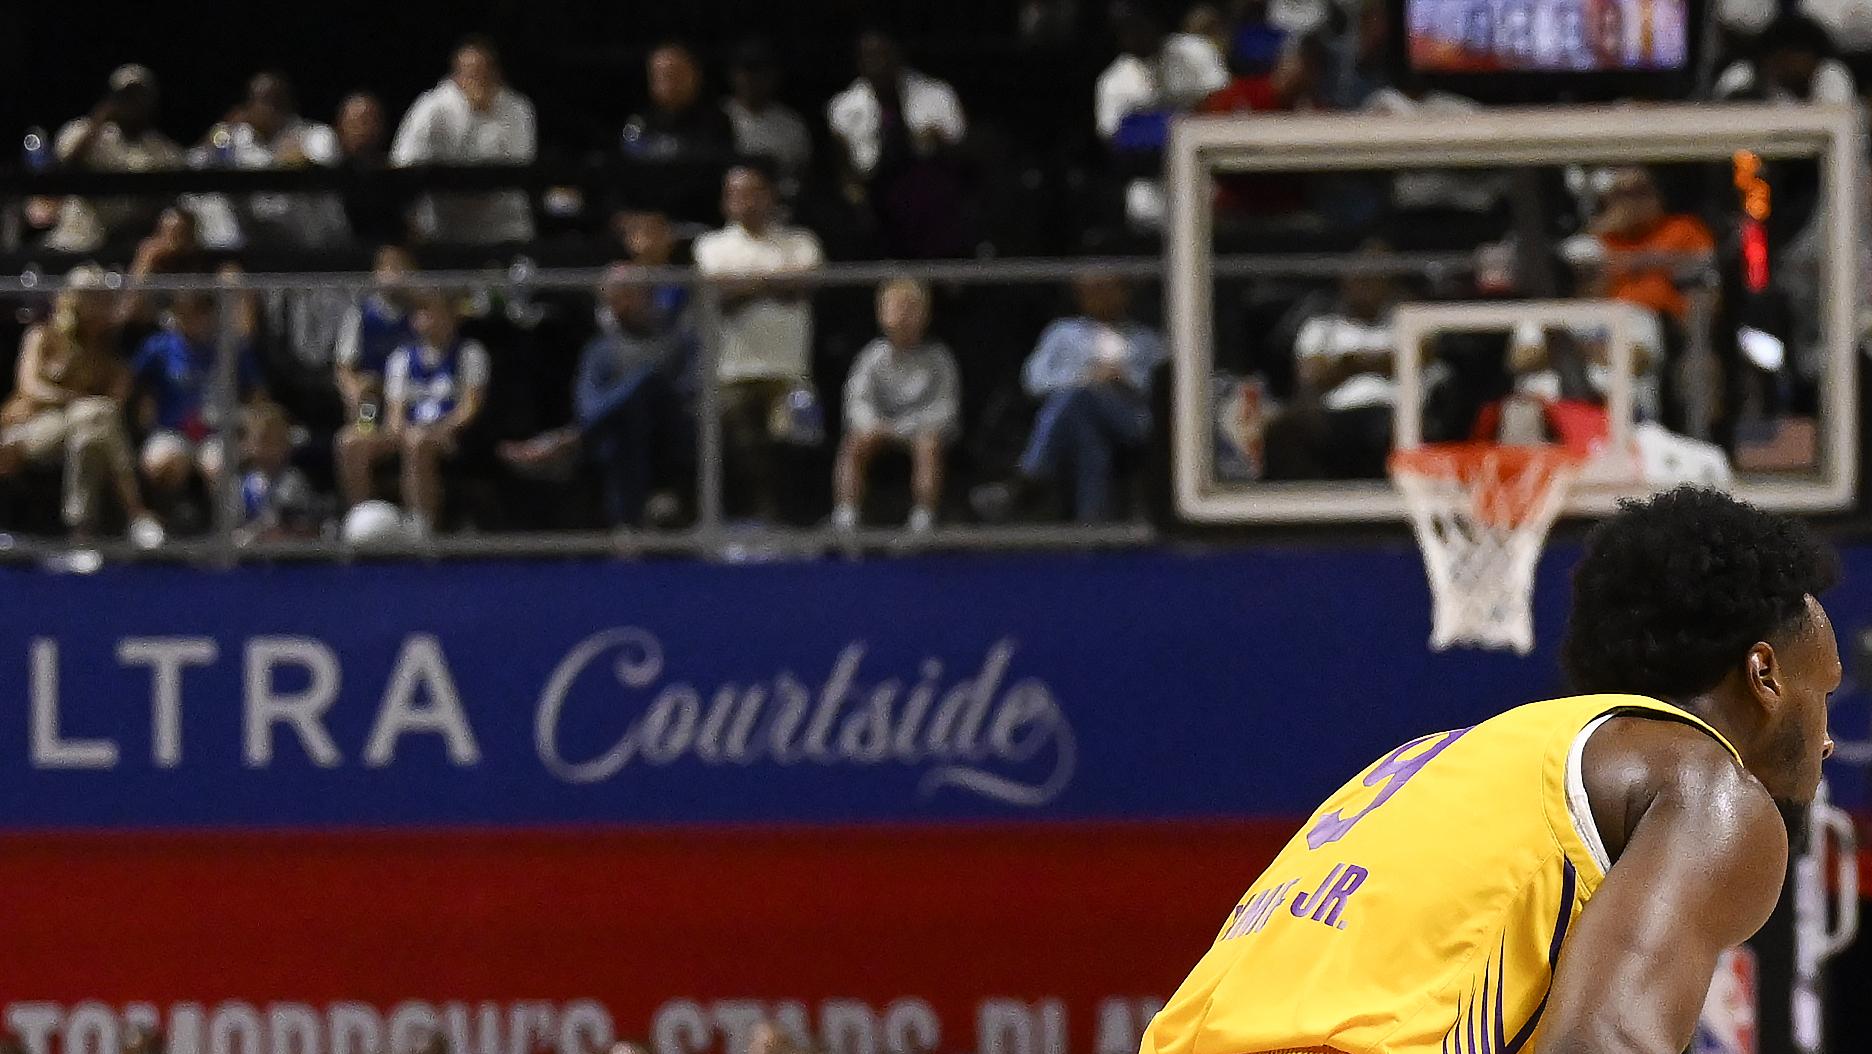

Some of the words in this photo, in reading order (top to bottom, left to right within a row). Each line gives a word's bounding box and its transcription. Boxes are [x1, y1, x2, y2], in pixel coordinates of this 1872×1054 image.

[28, 633, 484, 768] LTRA
[533, 625, 1078, 804] Courtside
[1306, 726, 1477, 851] 9
[1290, 862, 1368, 931] JR.
